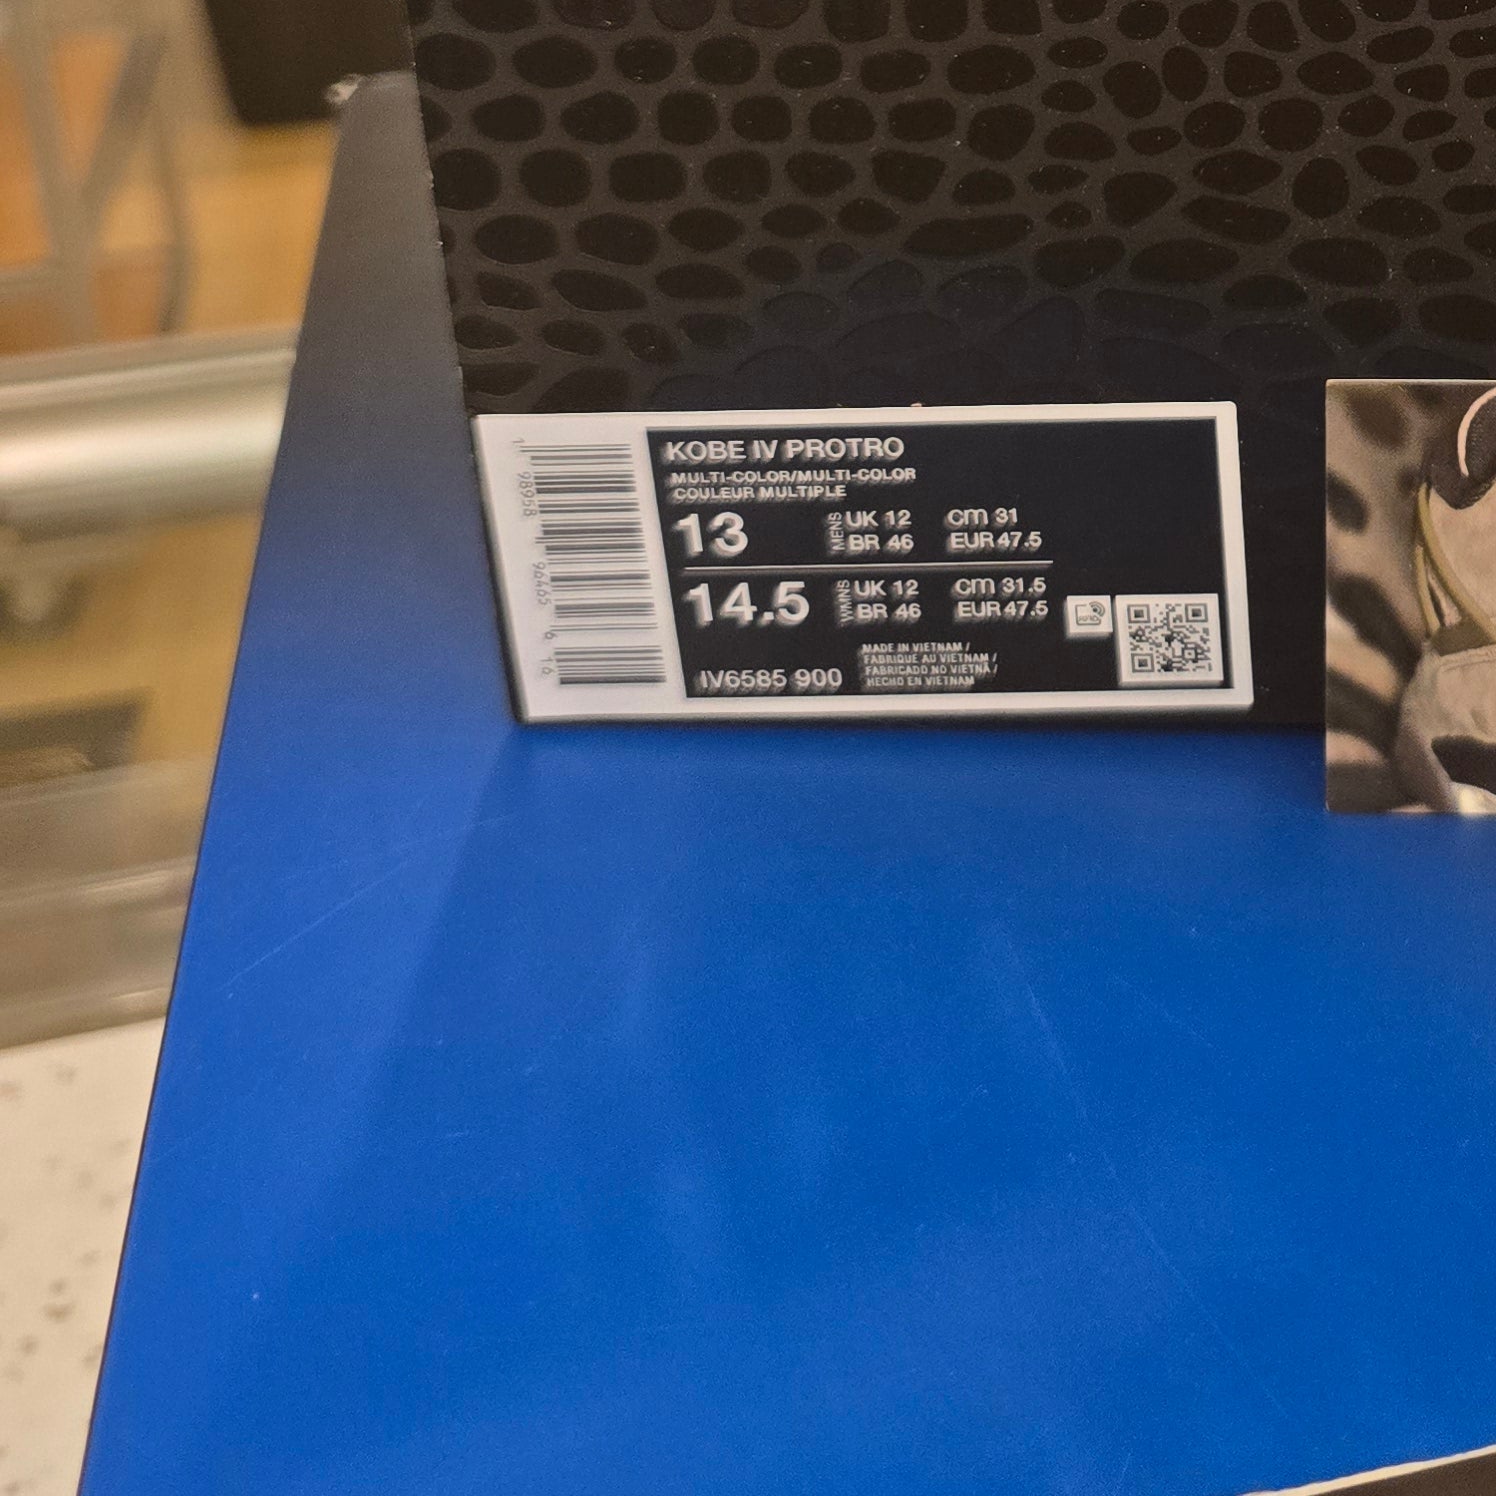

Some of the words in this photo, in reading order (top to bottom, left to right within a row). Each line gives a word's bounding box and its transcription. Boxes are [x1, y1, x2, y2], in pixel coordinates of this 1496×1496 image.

[664, 440, 747, 463] KOBE
[751, 439, 778, 461] IV
[783, 437, 904, 461] PROTRO
[668, 467, 917, 486] MULTI-COLOR/MULTI-COLOR
[672, 486, 755, 502] COULEUR
[758, 485, 847, 499] MULTIPLE
[845, 511, 878, 528] UK
[885, 509, 912, 526] 12
[994, 507, 1018, 525] 31
[674, 512, 749, 554] 13
[827, 511, 845, 552] MENS
[950, 531, 995, 550] EUR
[997, 530, 1043, 548] 47.5
[848, 533, 880, 552] BR
[886, 533, 914, 551] 46
[853, 580, 887, 597] UK
[891, 579, 919, 596] 12
[1001, 576, 1046, 594] 31.5
[686, 581, 810, 625] 14.5
[836, 579, 855, 624] WMNS
[957, 600, 1001, 619] EUR
[1003, 600, 1049, 618] 47.5
[856, 603, 888, 620] BR
[894, 603, 922, 619] 46
[862, 643, 895, 654] MADE
[897, 643, 909, 652] IN
[912, 641, 962, 652] VIETNAM
[863, 654, 919, 664] FABRIQUE
[921, 653, 937, 663] AU
[940, 652, 989, 663] VIETNAM
[698, 669, 788, 690] IV6585
[793, 668, 843, 688] 900
[865, 665, 928, 676] FABRICADO
[930, 664, 947, 675] NO
[866, 677, 904, 686] HECHO
[907, 676, 922, 685] EN
[924, 675, 975, 685] VIETNAM
